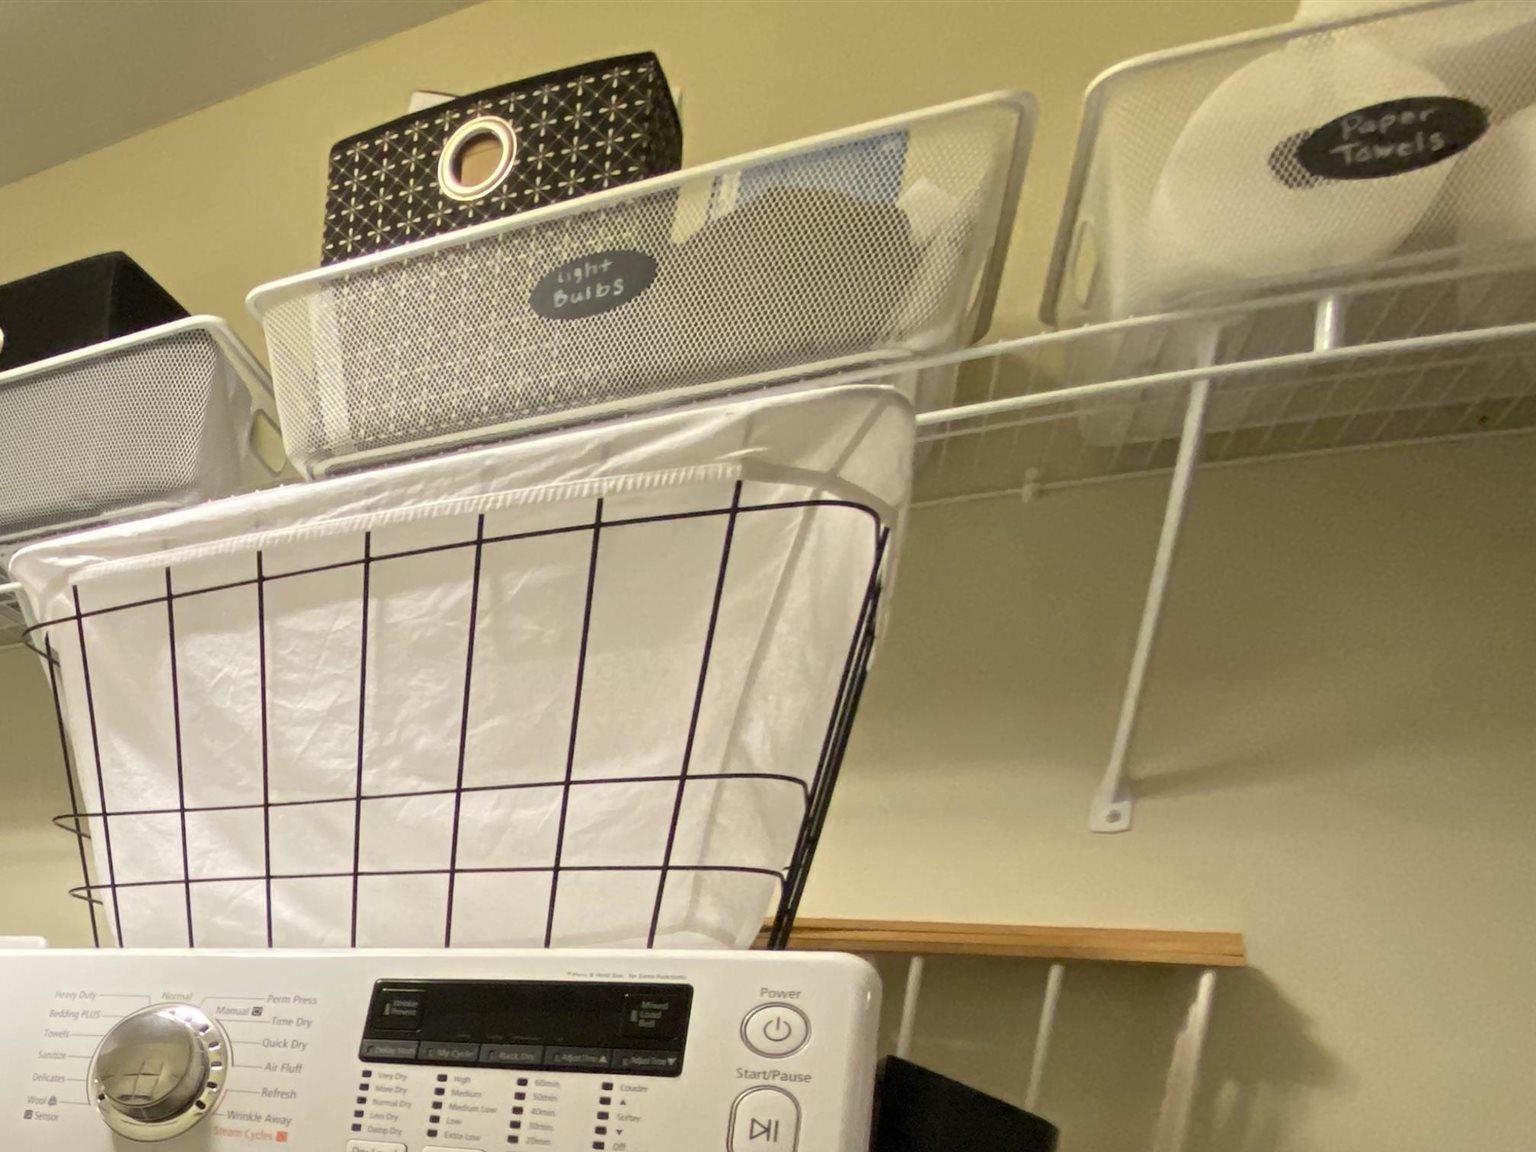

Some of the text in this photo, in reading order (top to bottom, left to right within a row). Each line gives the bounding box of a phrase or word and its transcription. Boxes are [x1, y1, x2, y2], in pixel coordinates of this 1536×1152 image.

[1340, 106, 1439, 140] Paper
[1329, 130, 1446, 165] Towels
[55, 990, 97, 1001] Heavy Duty
[161, 992, 193, 1001] Normal
[760, 987, 802, 999] Power
[49, 1009, 101, 1020] Bedding PLUS
[215, 1006, 250, 1016] Manual
[272, 1016, 313, 1029] Time Dry
[44, 1028, 70, 1039] Towels
[262, 1039, 308, 1051] Quick Dry
[264, 1063, 303, 1074] Air Fluff
[32, 1073, 66, 1082] Delicates
[394, 1073, 407, 1082] Dry
[736, 1067, 813, 1083] Start/Pause
[261, 1087, 297, 1099] Refresh
[395, 1086, 407, 1095] Dry
[399, 1100, 412, 1109] Dry
[34, 1111, 59, 1121] Sensor
[227, 1110, 293, 1127] Wrinkle Away
[386, 1113, 399, 1122] Dry
[246, 1128, 273, 1142] Cycles
[388, 1127, 402, 1137] Dry
